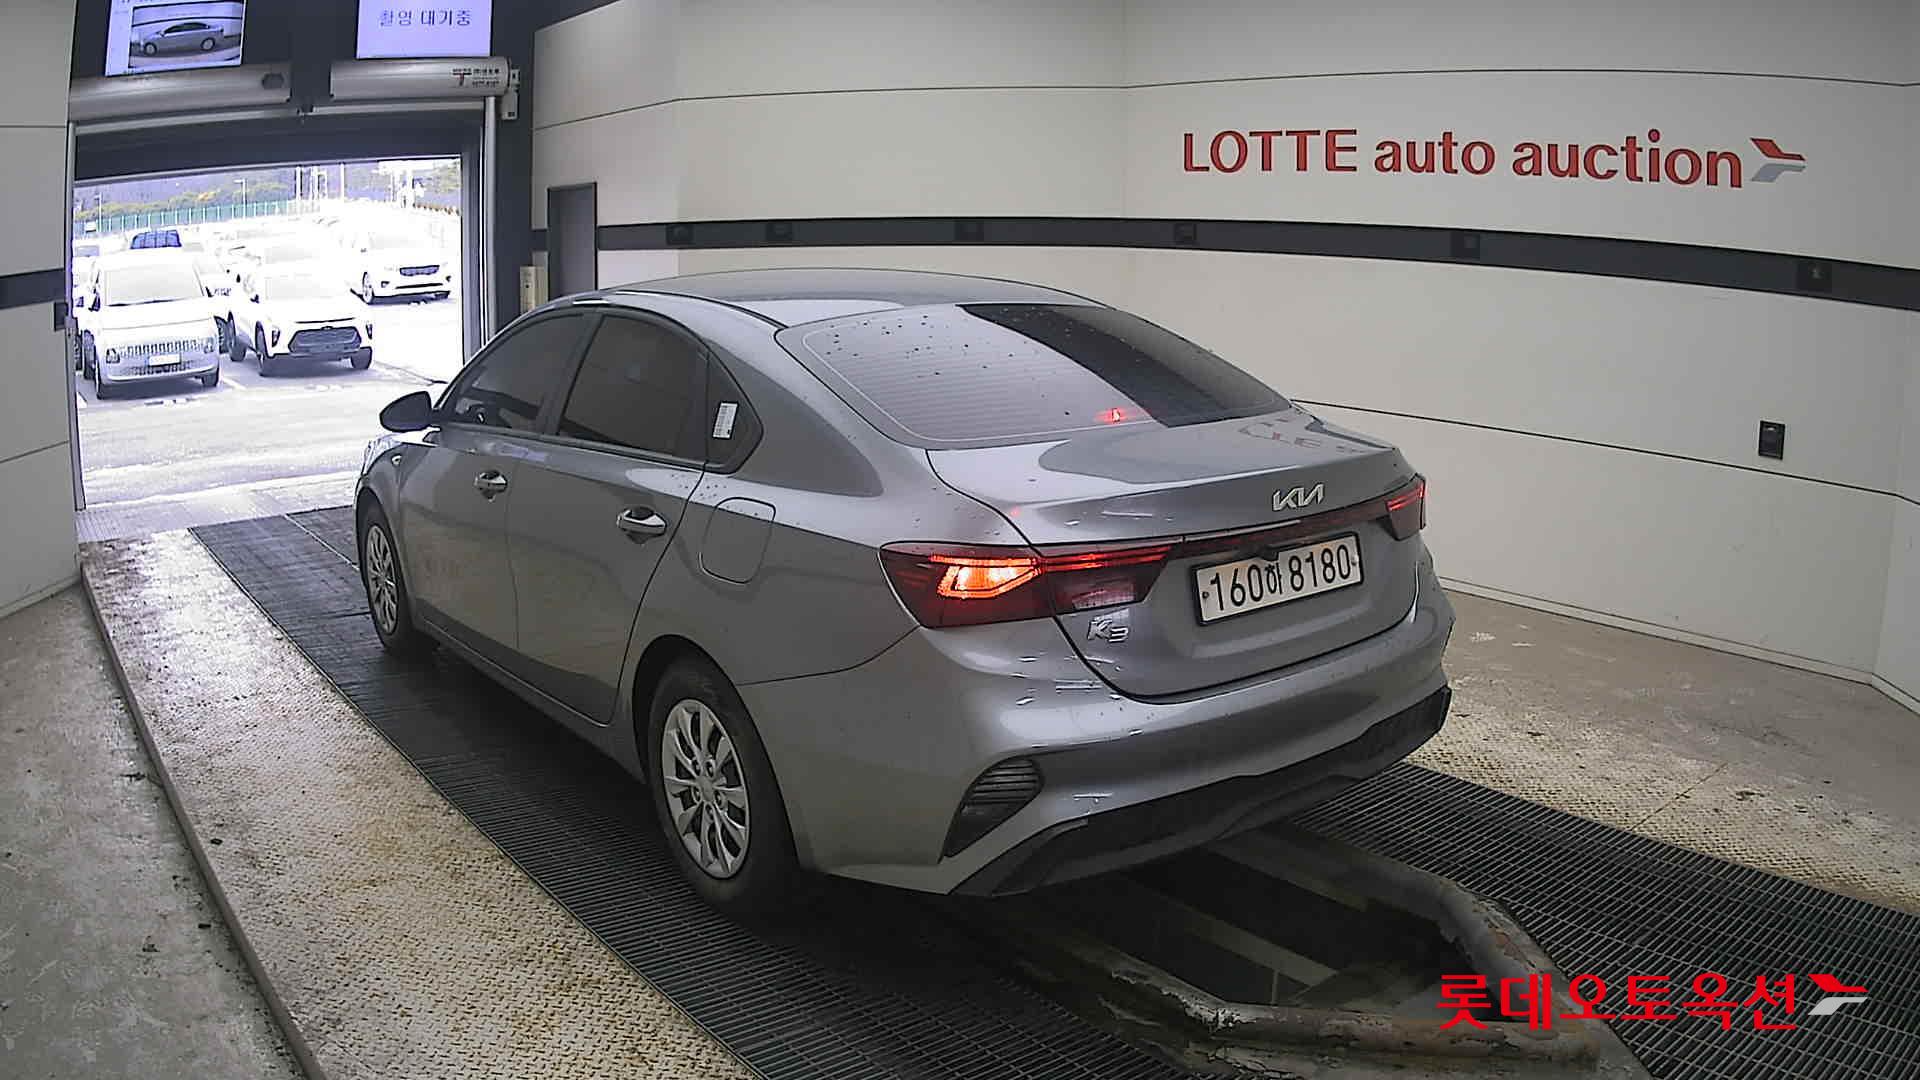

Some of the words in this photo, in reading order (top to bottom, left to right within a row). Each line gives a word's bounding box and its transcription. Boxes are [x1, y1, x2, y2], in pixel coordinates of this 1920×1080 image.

[420, 9, 472, 26] 대기중
[1182, 128, 1358, 173] LOTTE
[1374, 131, 1496, 175] auto
[1512, 129, 1743, 188] auction
[1272, 483, 1325, 512] KIA
[1209, 562, 1283, 611] 160하
[1288, 544, 1352, 592] 8180
[1087, 614, 1129, 643] K3
